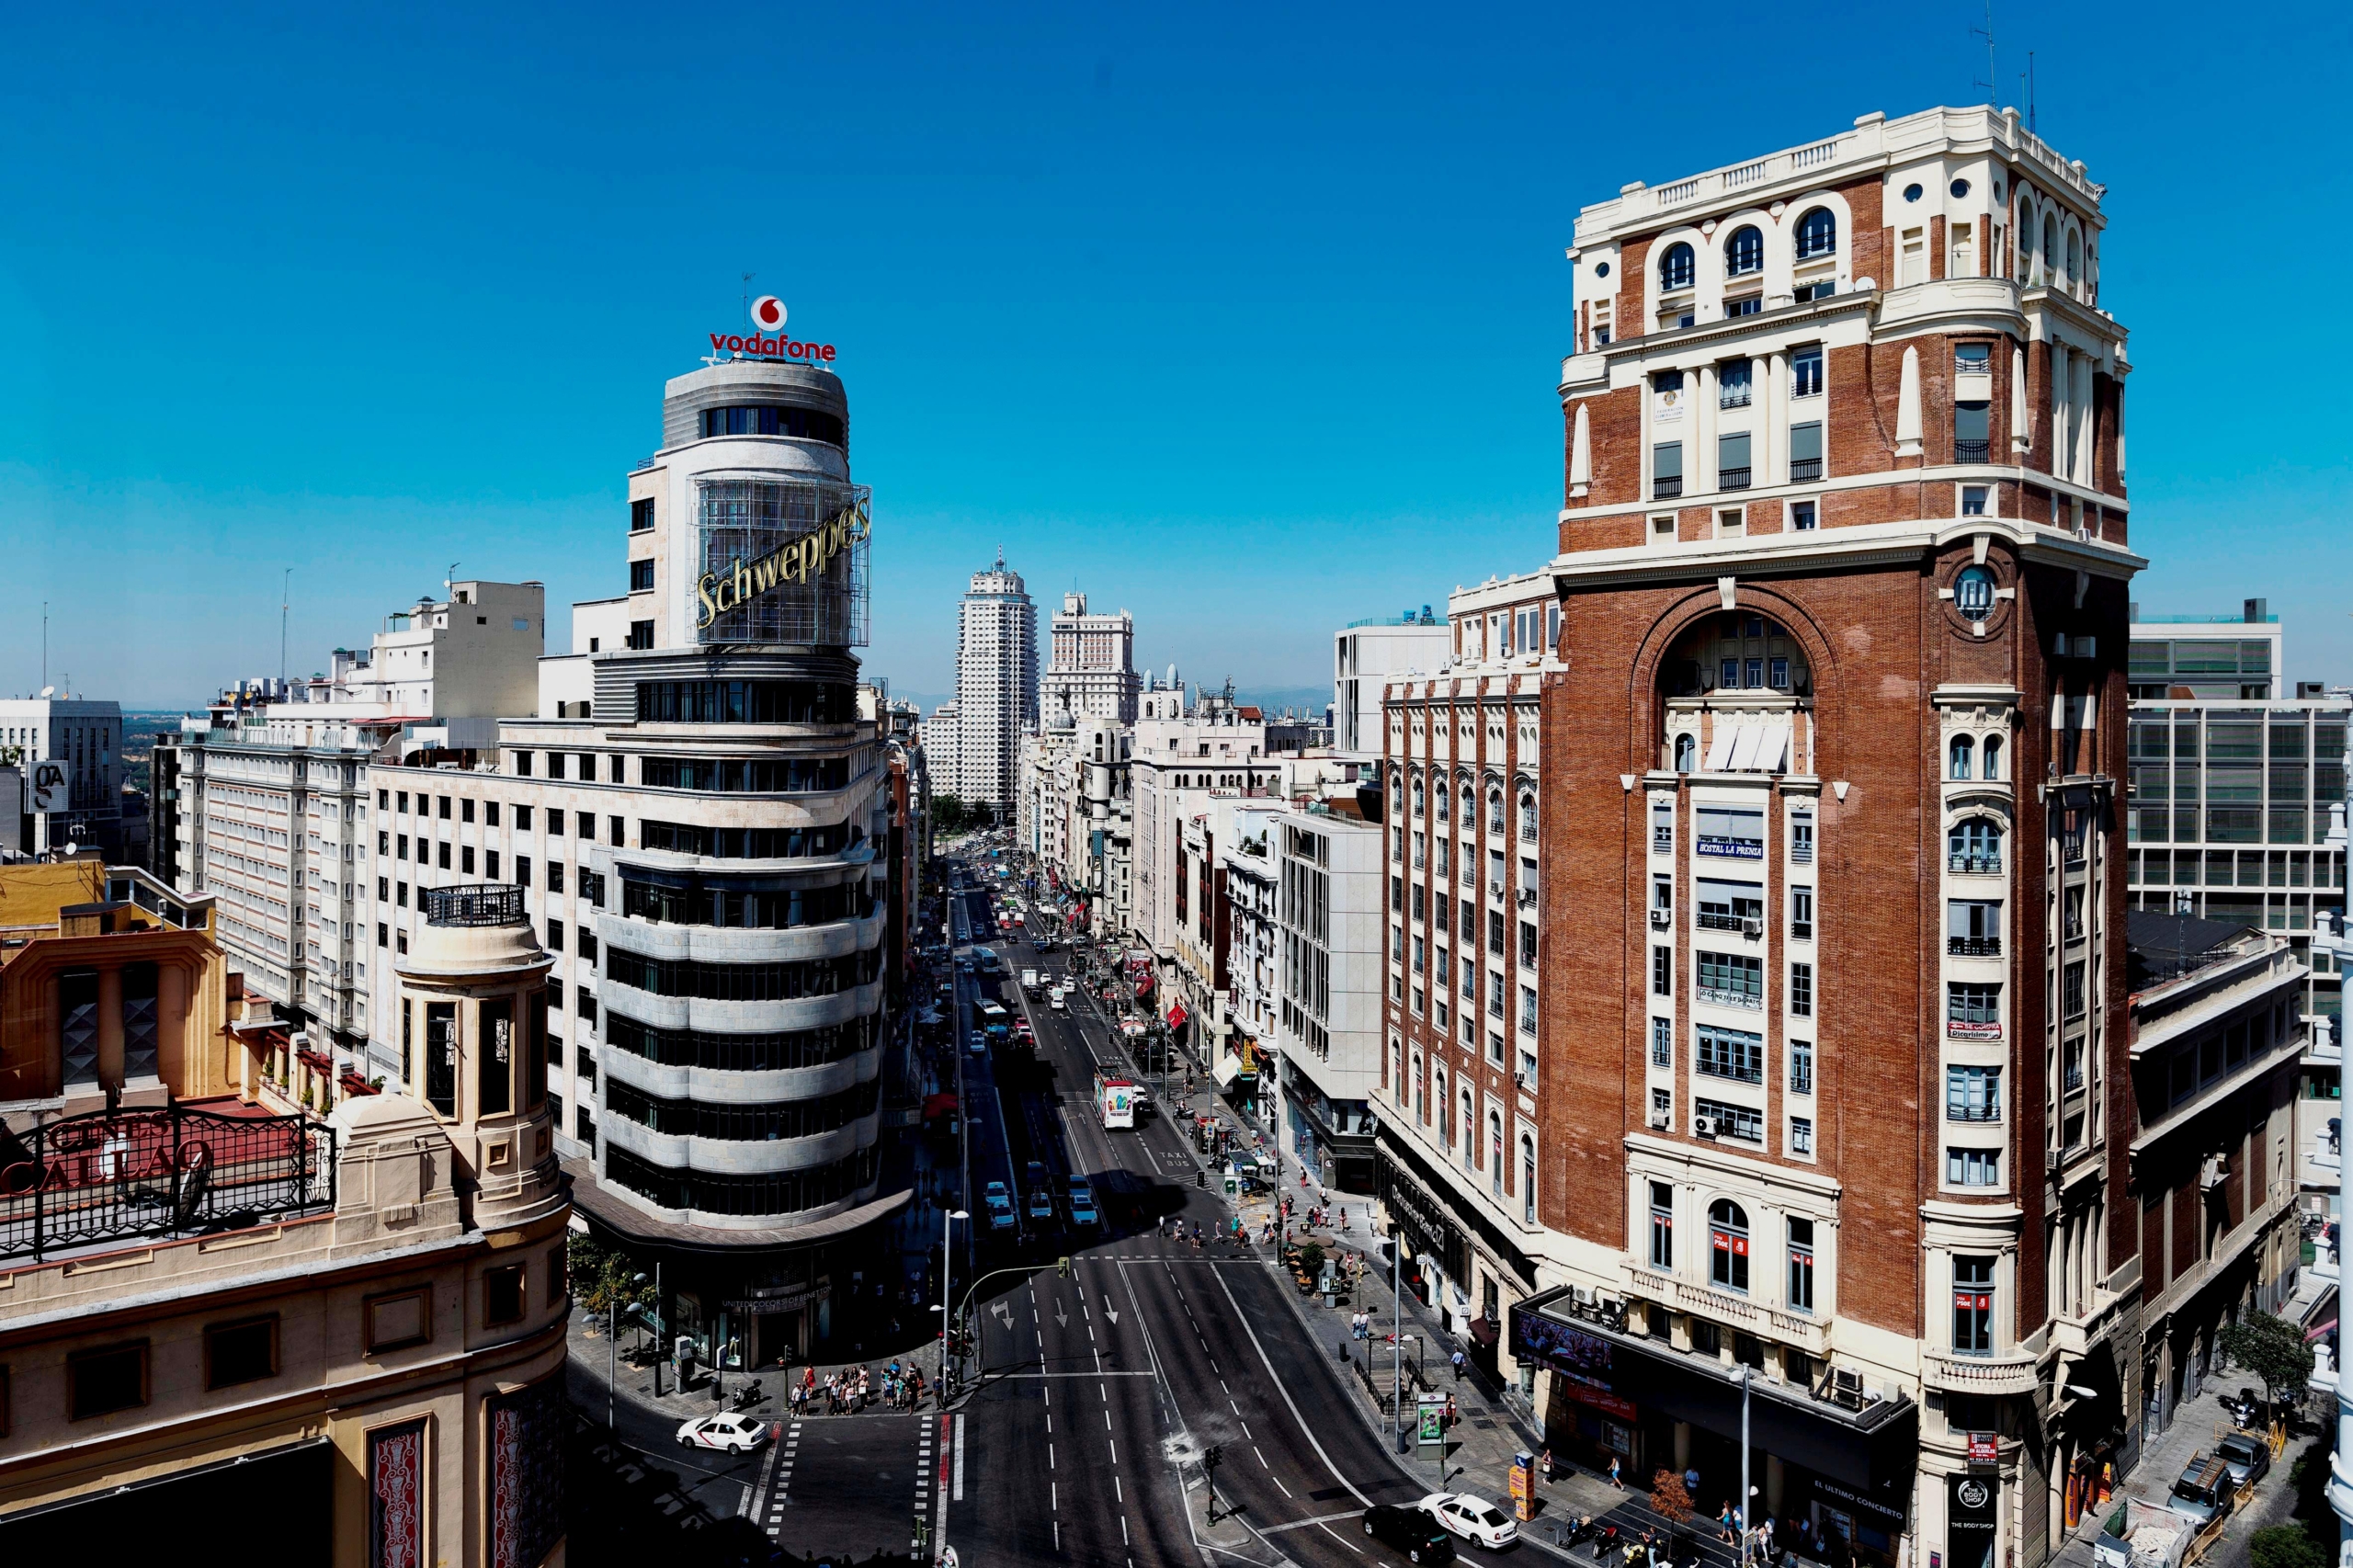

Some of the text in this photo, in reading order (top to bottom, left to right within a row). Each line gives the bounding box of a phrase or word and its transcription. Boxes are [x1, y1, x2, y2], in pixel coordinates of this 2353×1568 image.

[710, 332, 836, 361] vodafone
[697, 496, 870, 629] Schweppes
[1699, 844, 1762, 856] HOSTAL LA PRENSA
[1714, 1239, 1729, 1248] PSOE
[722, 1285, 832, 1308] UNITED COLORS OF BENETTON
[1814, 1480, 1904, 1520] EL ULTIMO CONCIERTO
